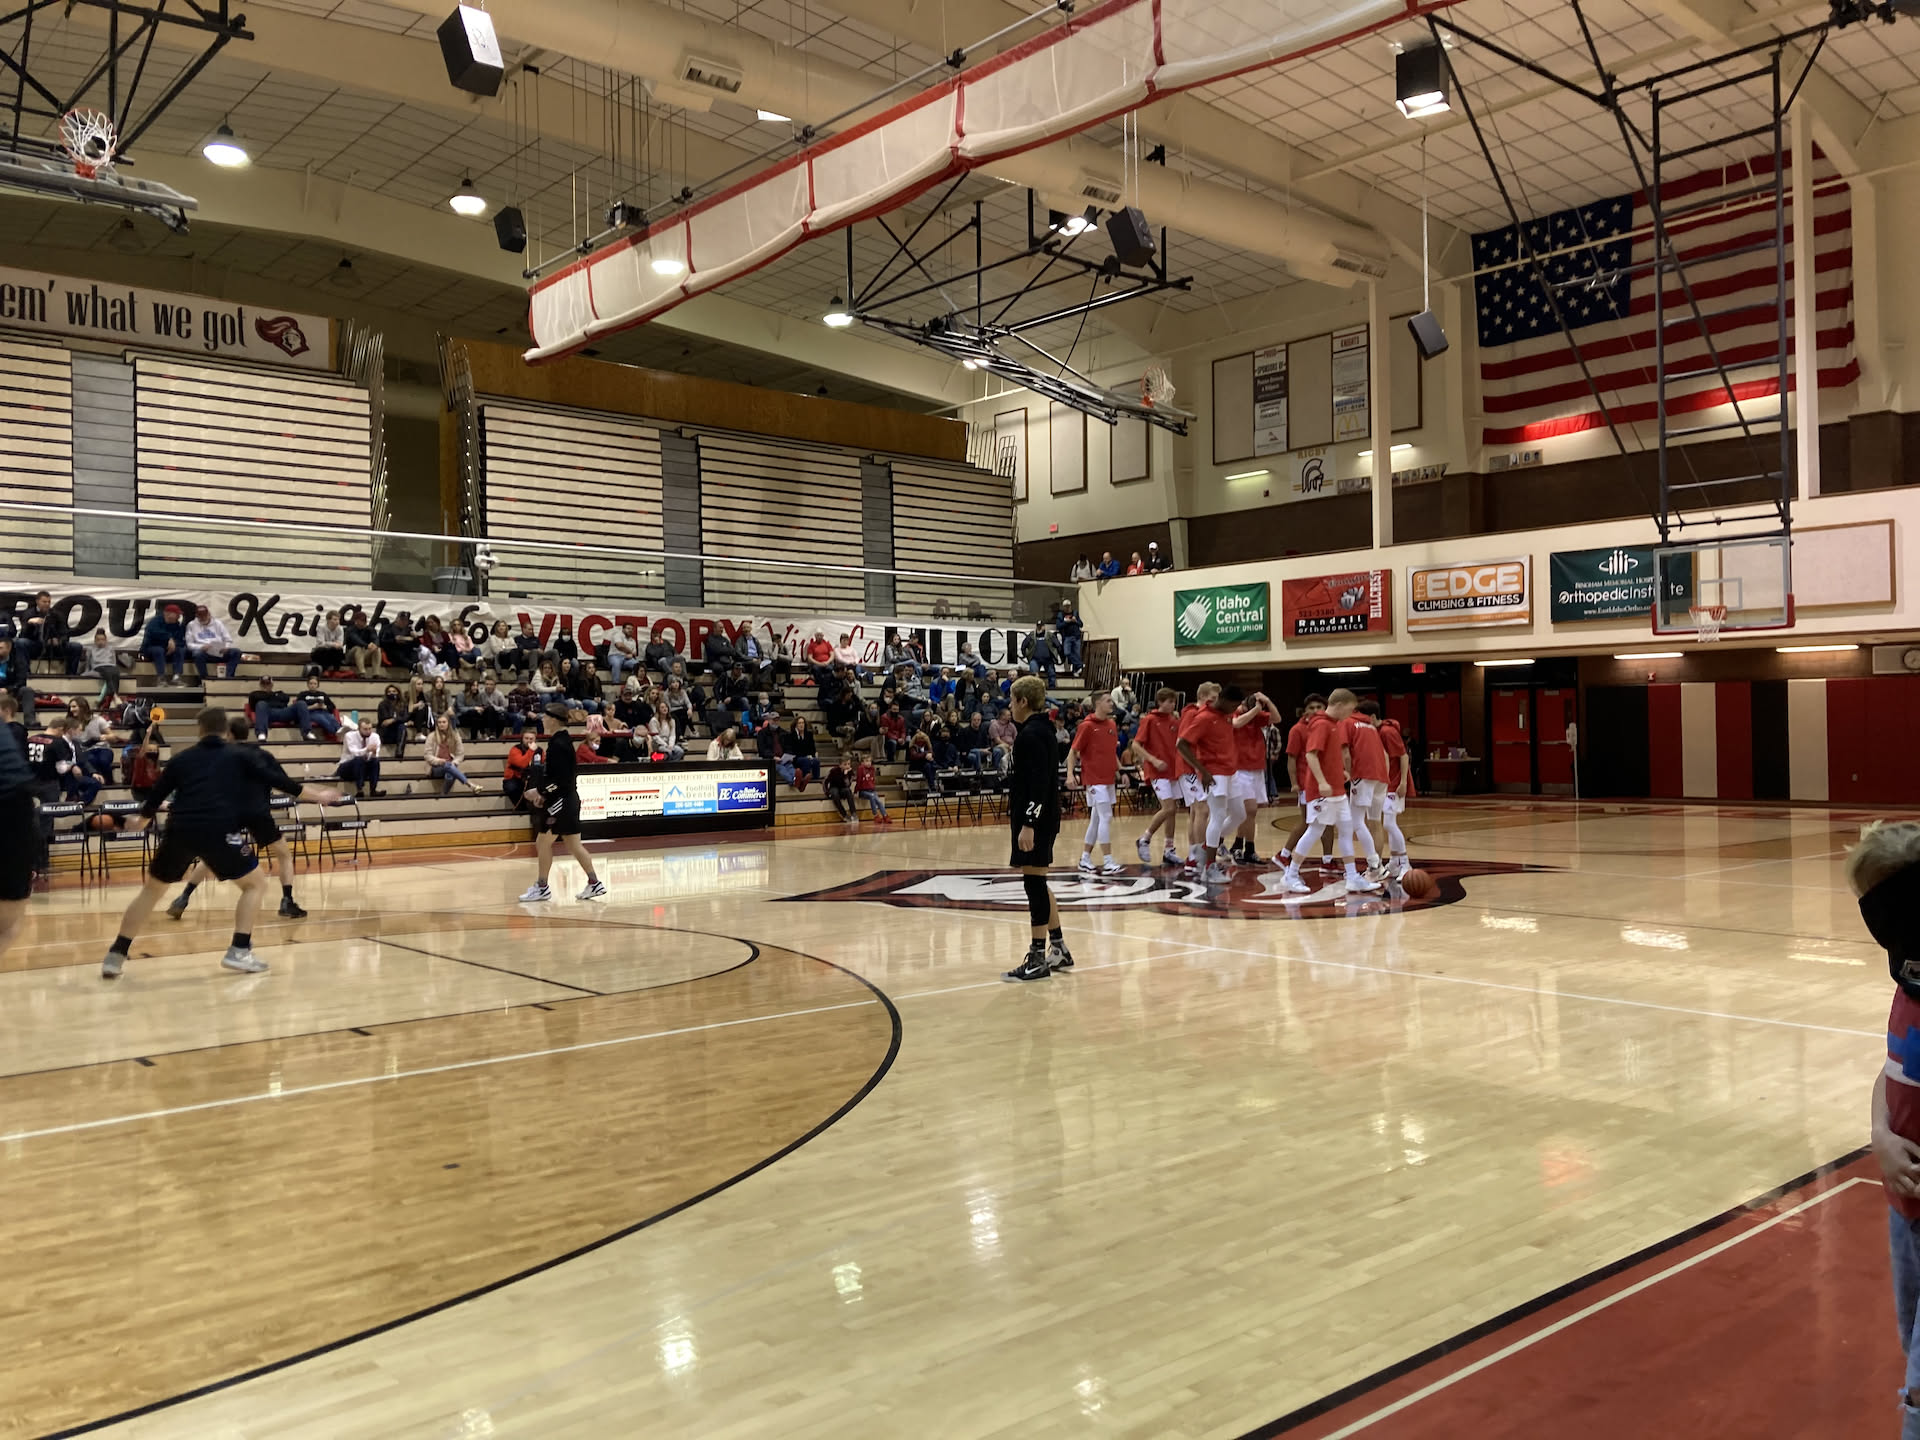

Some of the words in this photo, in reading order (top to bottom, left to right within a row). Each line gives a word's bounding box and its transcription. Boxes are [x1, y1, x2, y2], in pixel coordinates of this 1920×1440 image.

[66, 284, 140, 333] what
[152, 301, 192, 340] we
[203, 306, 248, 351] got
[1415, 574, 1426, 599] the
[1426, 565, 1521, 599] EDGE
[1216, 593, 1251, 610] Idaho
[1369, 569, 1382, 619] HILLCREST
[1417, 599, 1466, 611] CLIMBING
[1466, 597, 1475, 607] &
[1476, 593, 1520, 606] FITNESS
[1215, 606, 1265, 625] Central
[1298, 613, 1362, 627] Randall
[1216, 626, 1241, 634] CREDIT
[1242, 623, 1264, 632] UNION
[1298, 622, 1364, 634] orthodontics
[1025, 800, 1043, 819] 24
